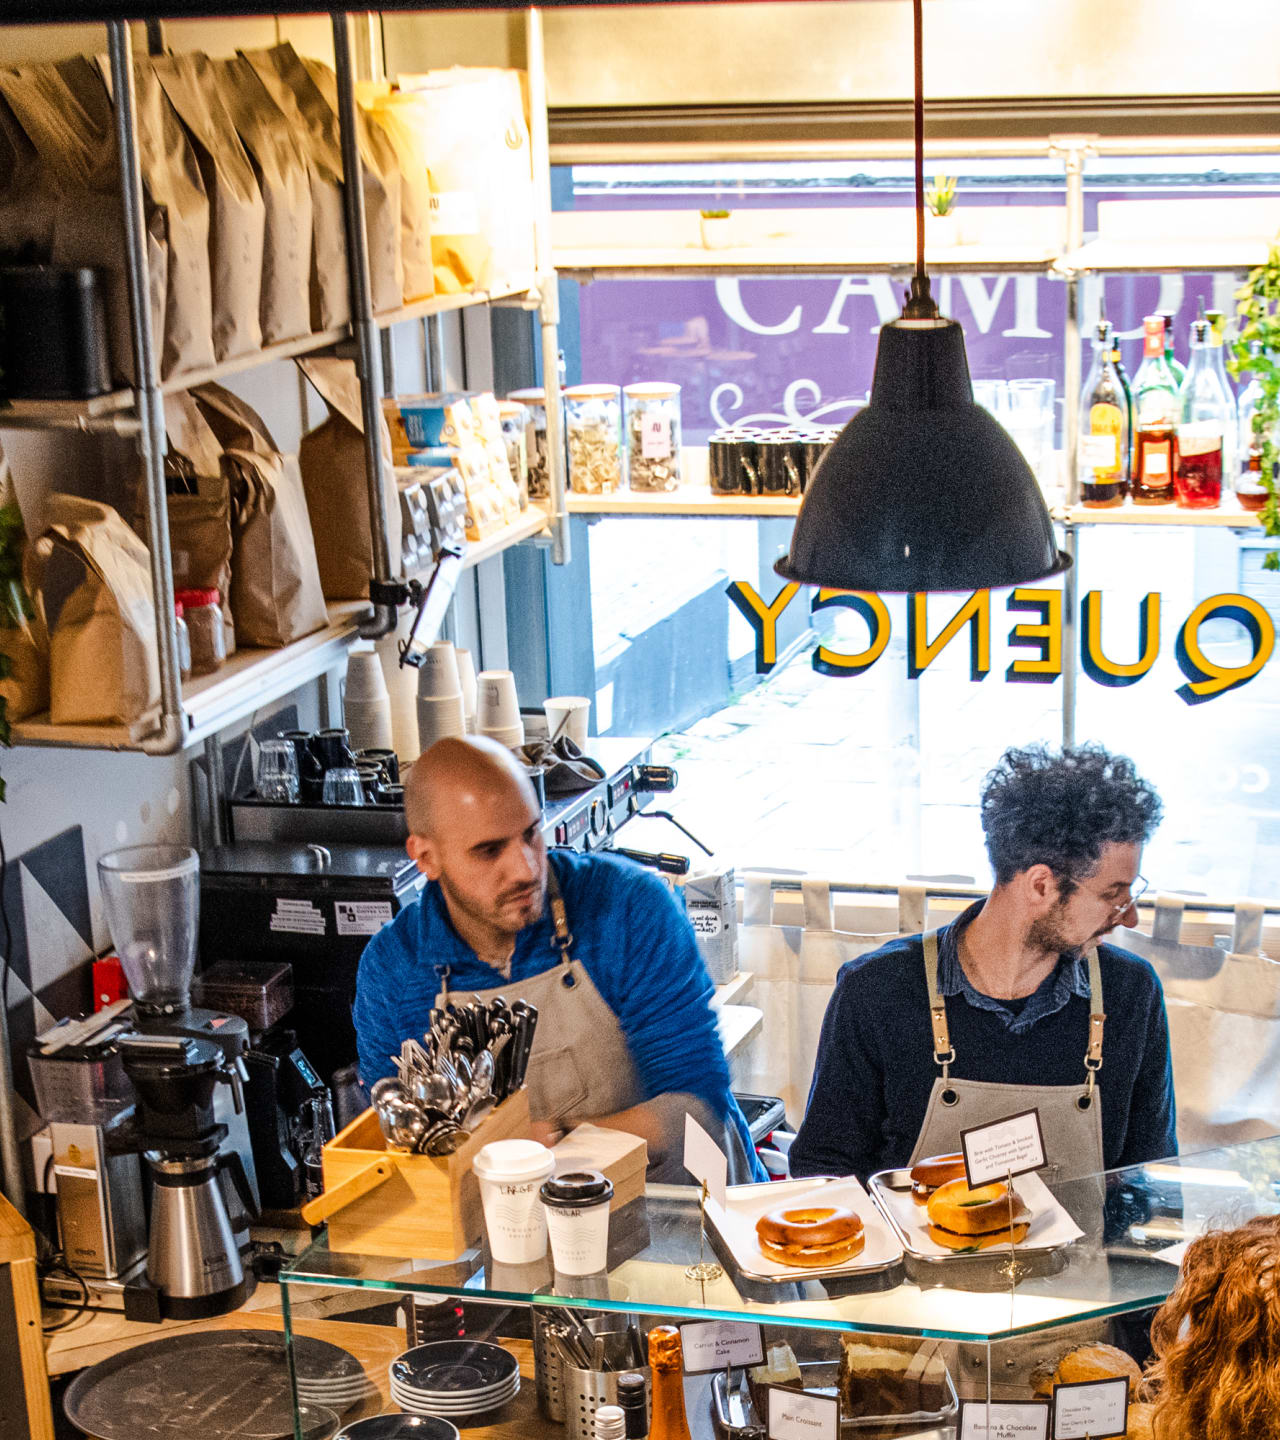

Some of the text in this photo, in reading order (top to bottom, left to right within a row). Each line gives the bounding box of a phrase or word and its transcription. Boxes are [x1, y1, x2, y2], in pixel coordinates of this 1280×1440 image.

[500, 1184, 534, 1196] LARGE
[715, 1339, 720, 1347] &
[721, 1336, 749, 1346] Cinnamon
[795, 1416, 823, 1428] Croissant
[996, 1431, 1016, 1439] Muffin
